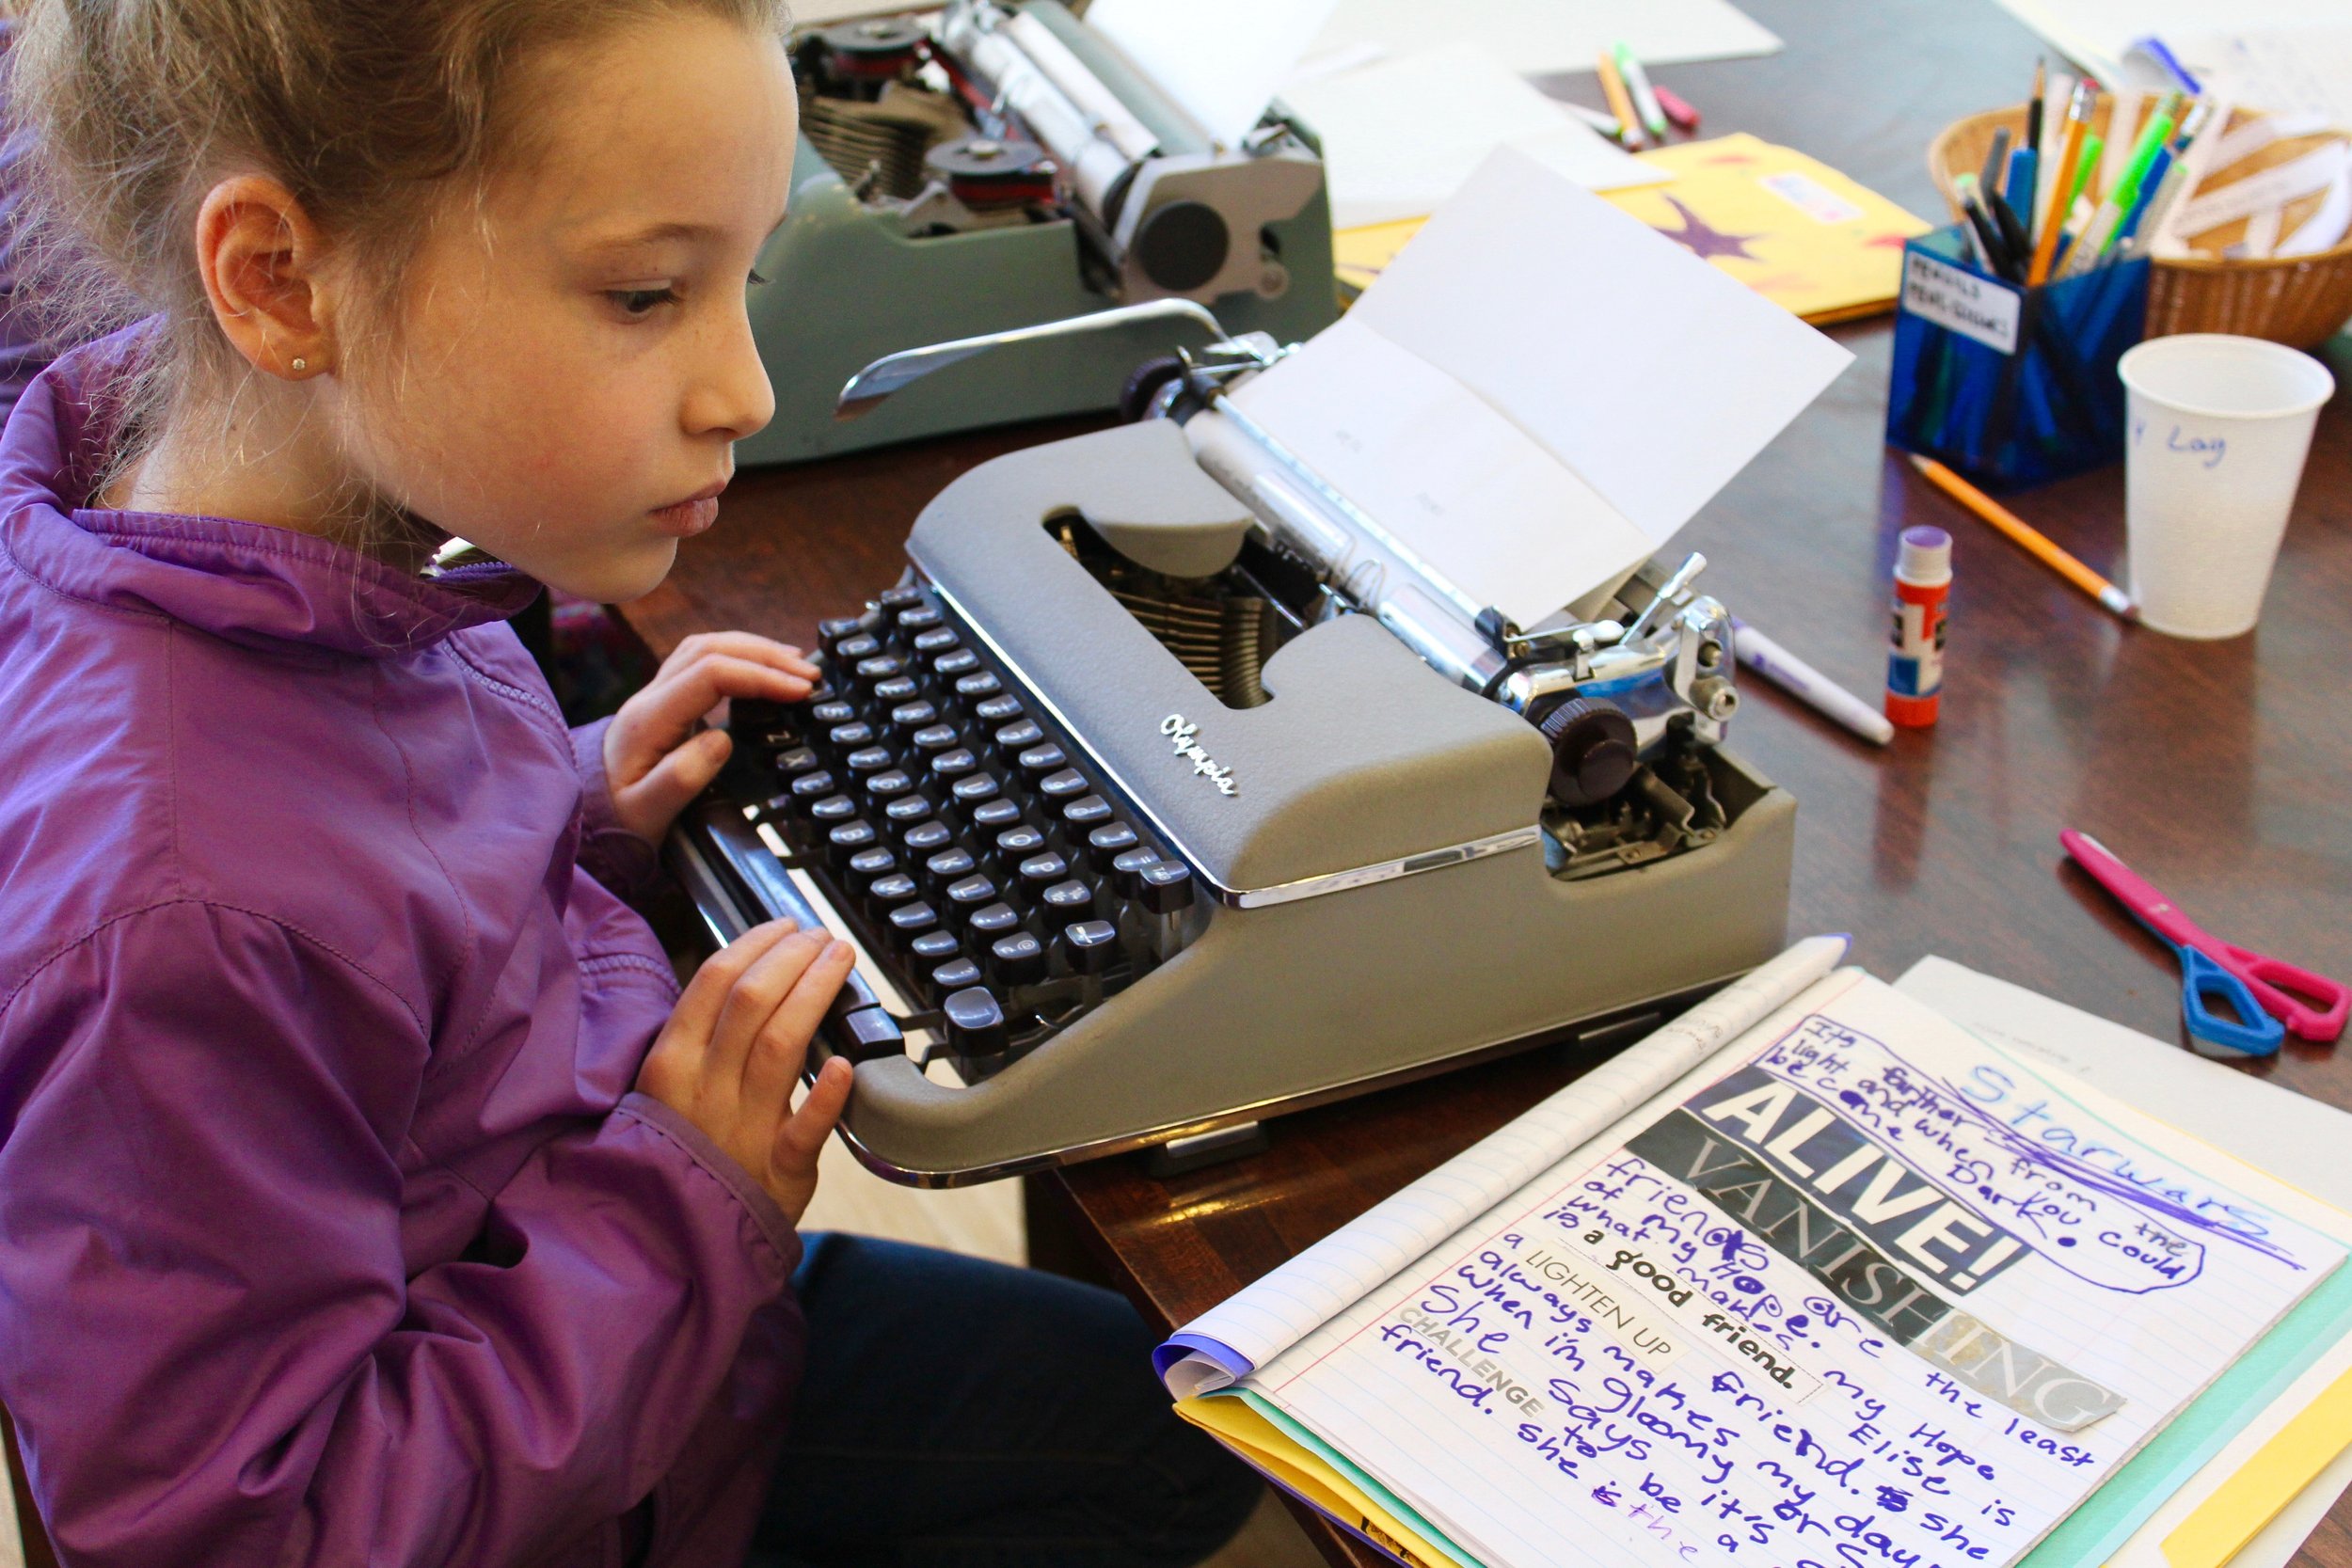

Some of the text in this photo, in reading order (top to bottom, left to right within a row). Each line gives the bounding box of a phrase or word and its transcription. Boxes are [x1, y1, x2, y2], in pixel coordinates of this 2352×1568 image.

[1160, 714, 1235, 795] Olympia
[1701, 1077, 2024, 1291] ALIVE!
[1791, 1038, 1851, 1074] light
[1857, 1079, 1915, 1117] and
[1914, 1118, 1994, 1180] when
[1583, 1180, 1624, 1201] of
[1642, 1213, 1697, 1263] my
[1685, 1136, 2111, 1429] VANISHING
[2010, 1156, 2097, 1212] from
[2135, 1222, 2189, 1258] the
[1380, 1323, 1493, 1415] friend.
[1517, 1421, 1579, 1480] she
[1628, 1502, 1699, 1562] the
[1399, 1307, 1546, 1418] CHALLENGE
[1479, 1250, 1593, 1333] always
[1603, 1345, 1740, 1447] makes
[1756, 1461, 1817, 1507] my
[1503, 1233, 1525, 1249] a
[1525, 1249, 1635, 1330] LIGHTEN
[1632, 1327, 1672, 1354] UP
[1920, 1512, 1990, 1560] she
[1543, 1205, 2015, 1526] is a good friend. Elise is
[1677, 1267, 1794, 1351] makes
[1823, 1370, 1886, 1420] my
[1909, 1422, 1995, 1481] Hope
[1804, 1296, 1884, 1358] are
[1926, 1372, 1982, 1418] the
[2004, 1418, 2094, 1466] least
[1595, 1377, 1735, 1484] gloomy
[1773, 1499, 1832, 1537] or
[1639, 1472, 1682, 1513] be
[1717, 1533, 1740, 1553] a
[1701, 1489, 1775, 1545] it's
